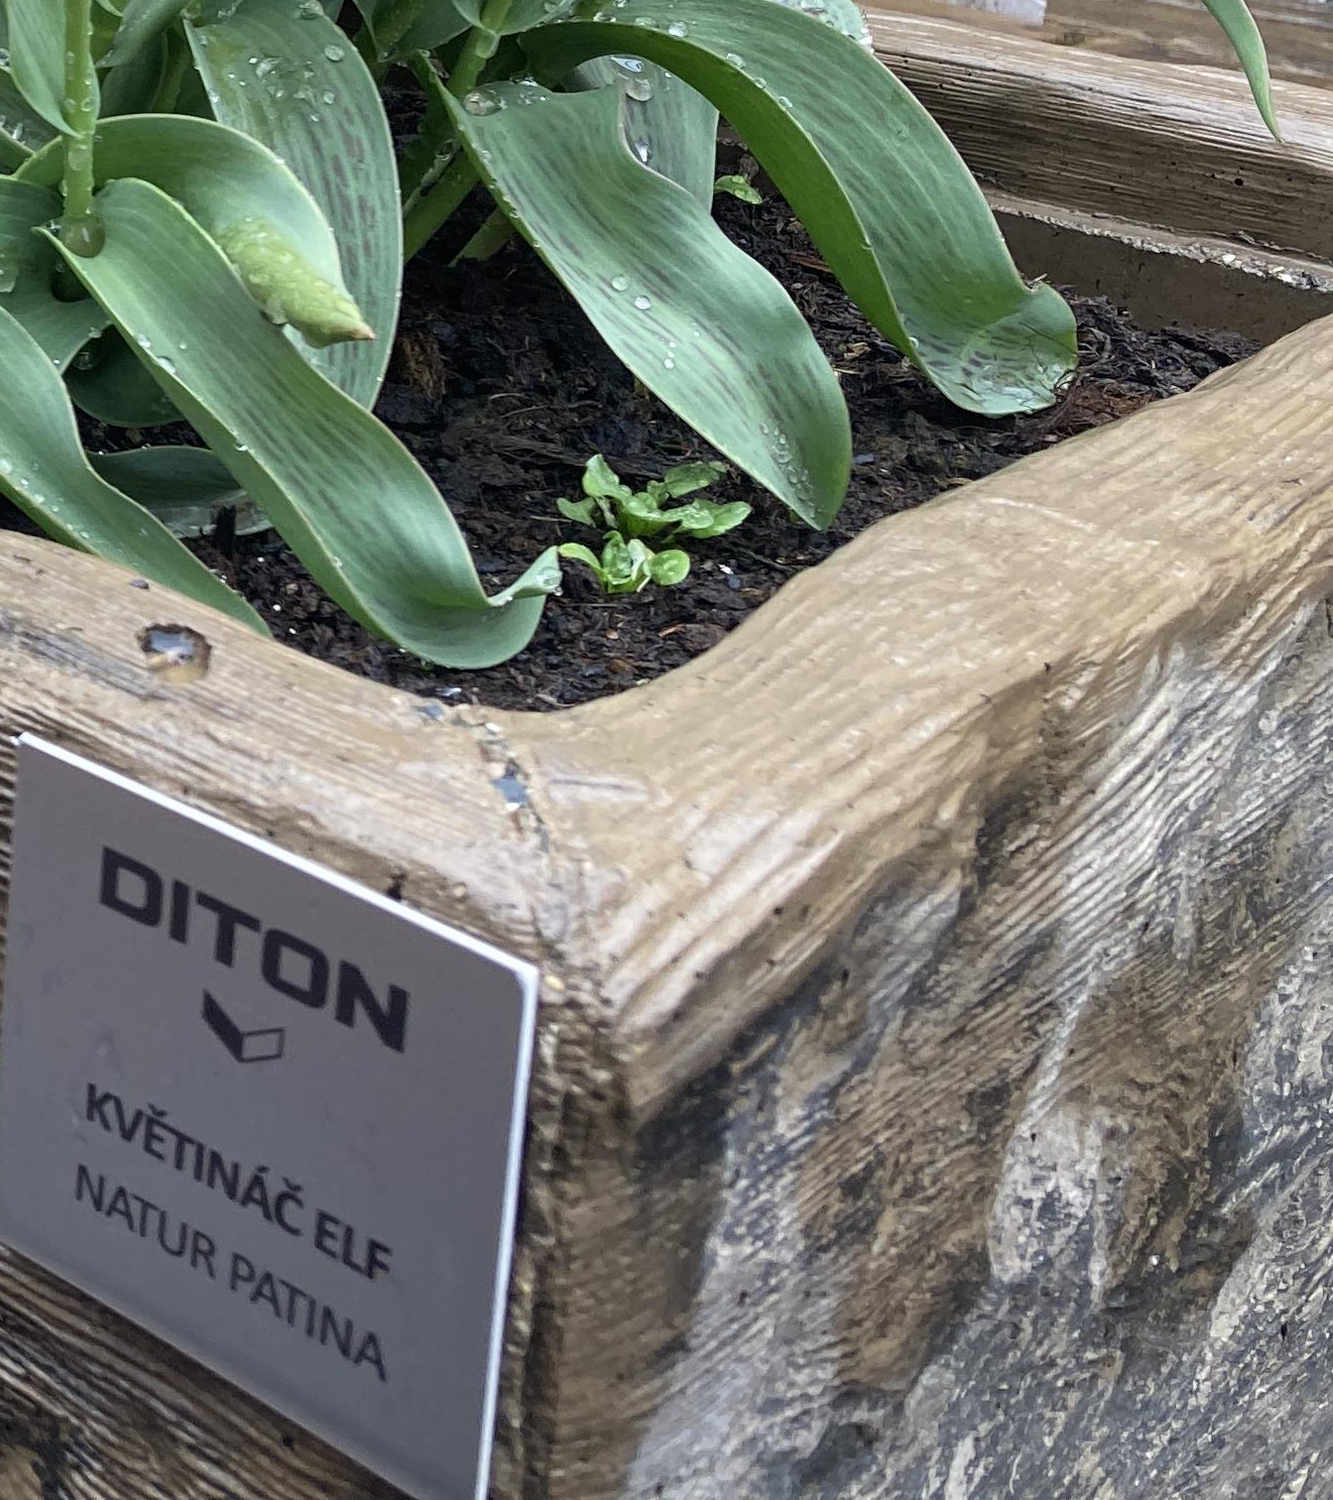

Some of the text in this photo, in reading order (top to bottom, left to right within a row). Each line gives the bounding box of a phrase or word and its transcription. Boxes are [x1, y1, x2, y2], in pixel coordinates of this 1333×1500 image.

[98, 846, 411, 1054] DITON
[75, 1163, 388, 1382] NATUR PATINA
[85, 1082, 393, 1280] KVĚTINÁČ ELF
